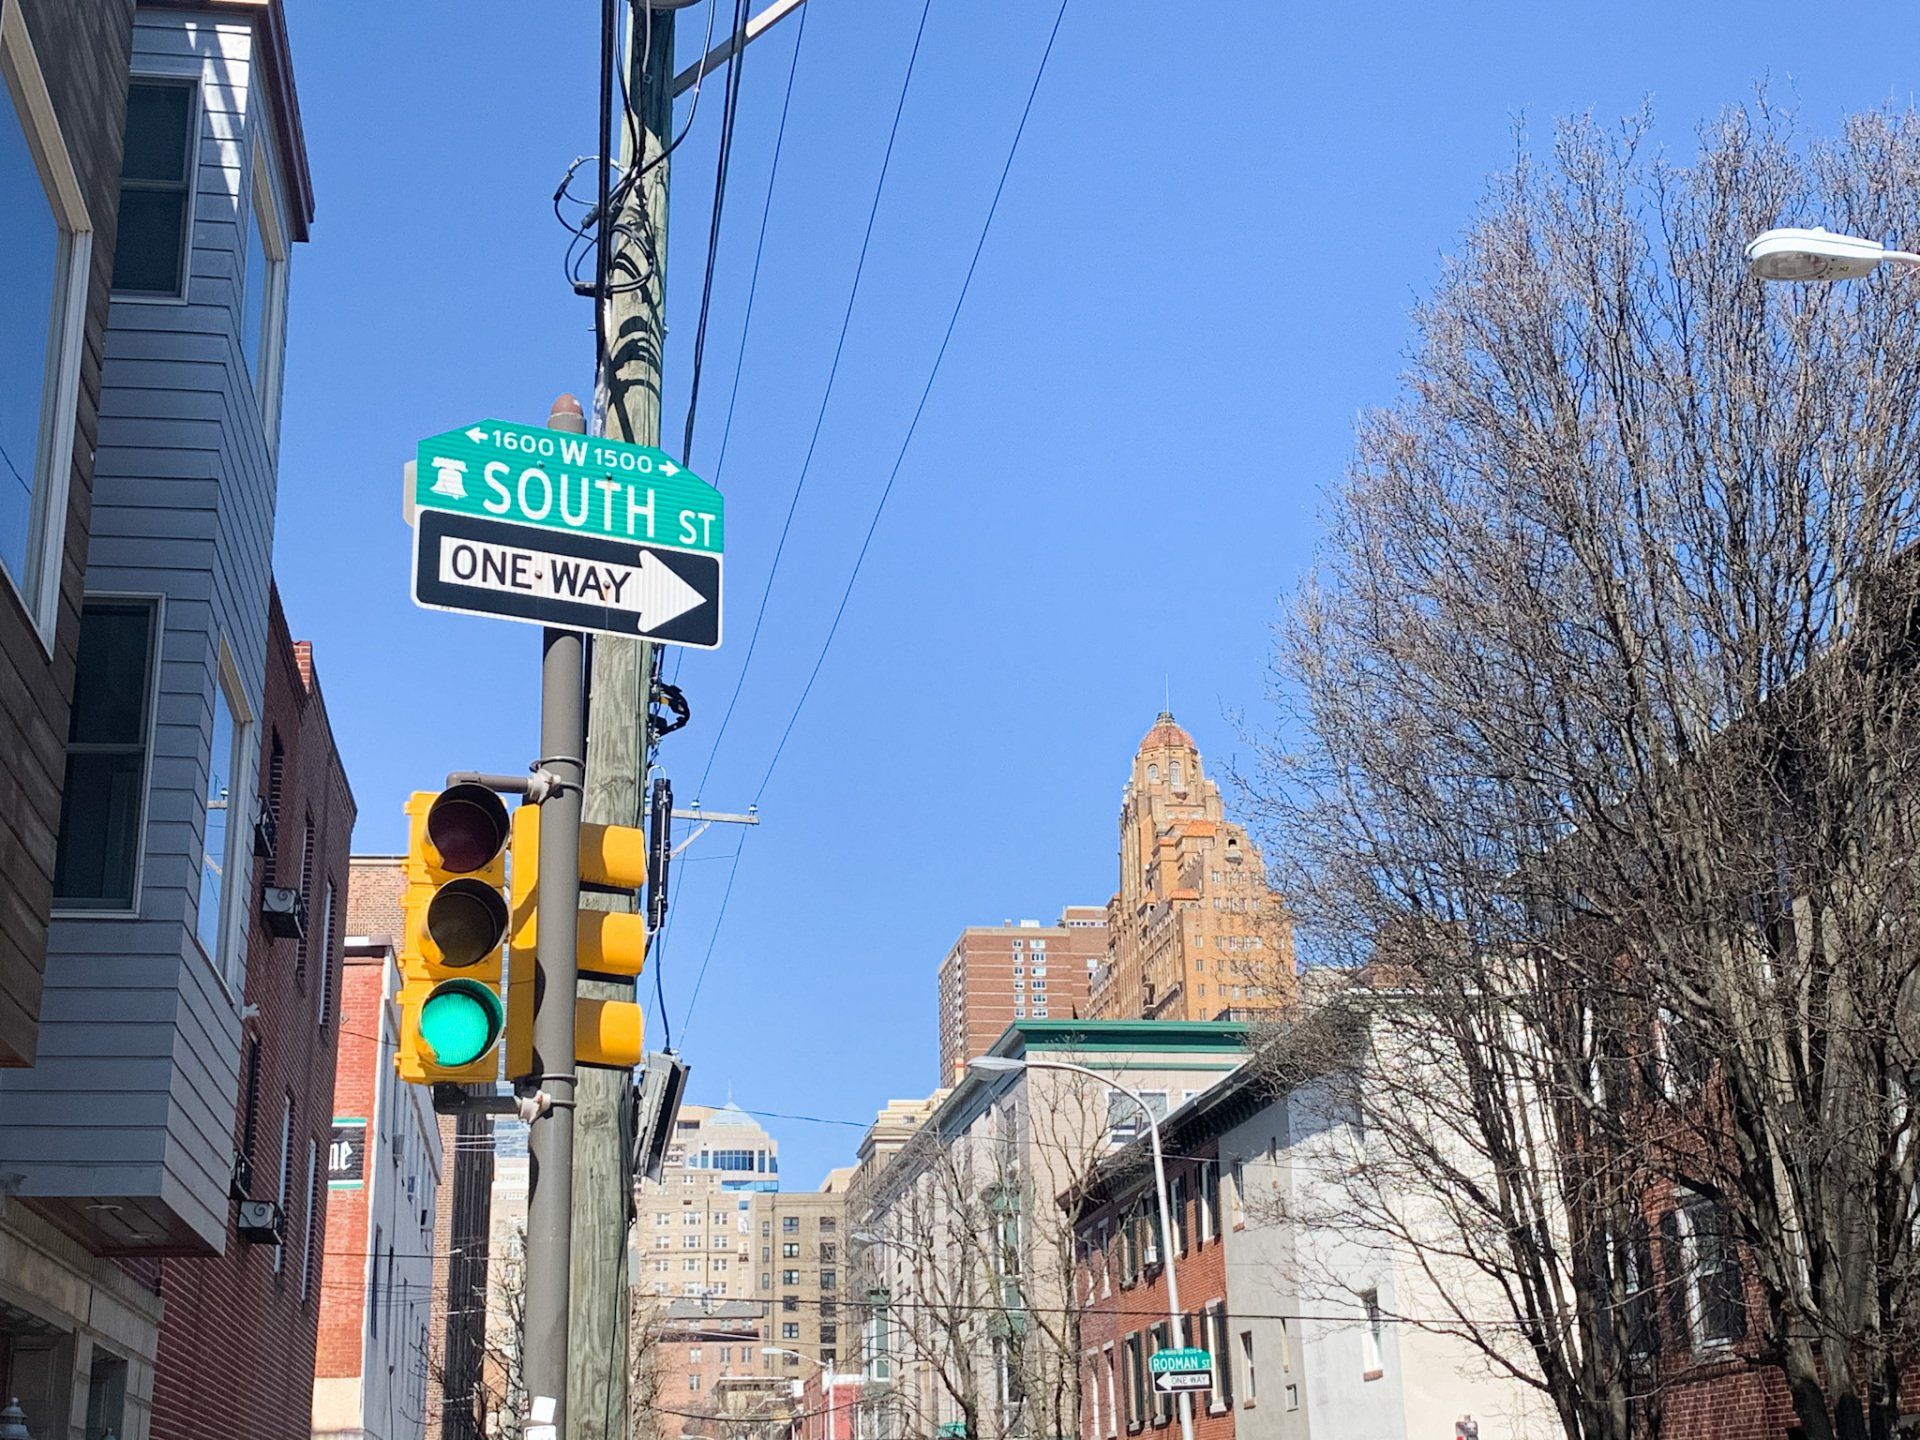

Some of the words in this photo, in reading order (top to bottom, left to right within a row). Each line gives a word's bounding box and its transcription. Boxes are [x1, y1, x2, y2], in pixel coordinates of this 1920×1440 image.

[492, 430, 554, 457] 1600
[559, 438, 588, 467] W
[594, 448, 652, 474] 1500
[483, 460, 655, 538] SOUTH
[679, 509, 716, 547] ST
[452, 544, 532, 589] ONE
[551, 559, 631, 603] WAY
[1153, 1356, 1198, 1371] RODMAN
[1201, 1359, 1210, 1368] ST
[1171, 1376, 1187, 1384] ONE
